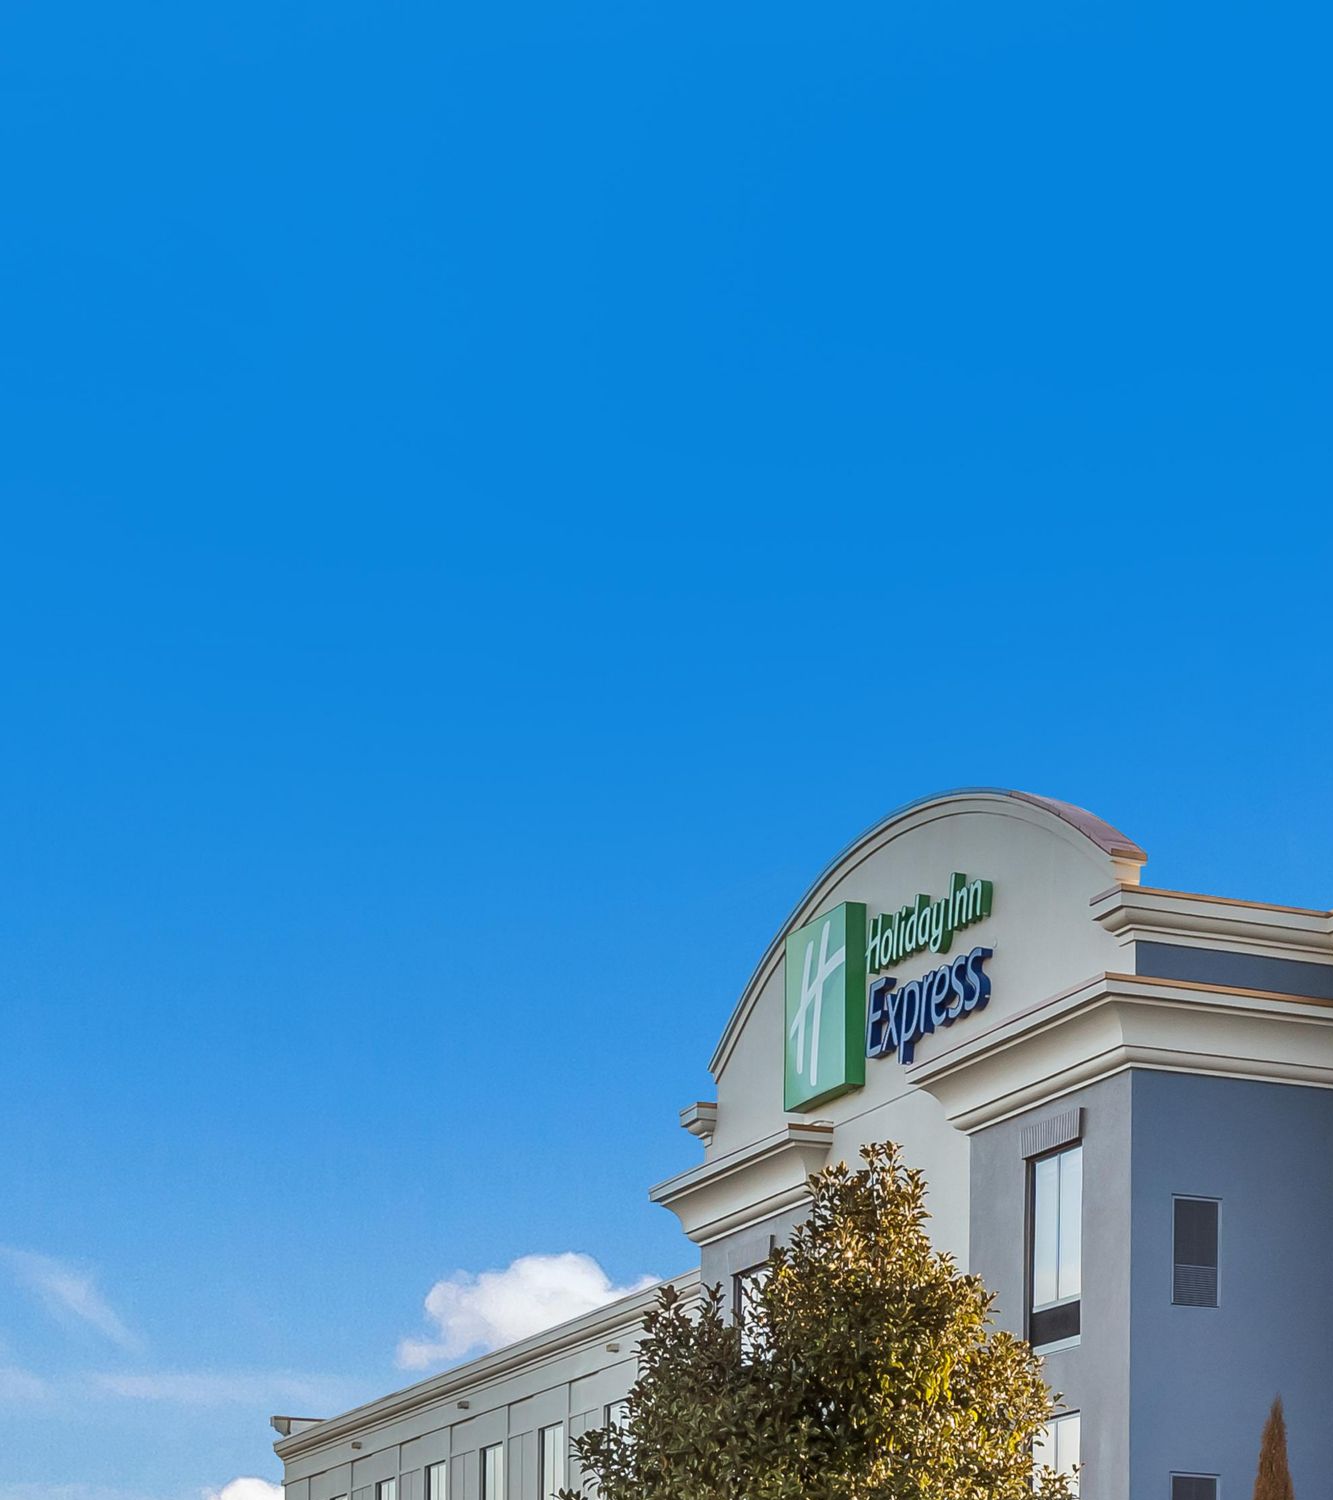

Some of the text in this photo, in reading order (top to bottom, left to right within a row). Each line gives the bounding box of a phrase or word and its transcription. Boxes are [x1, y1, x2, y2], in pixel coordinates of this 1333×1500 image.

[865, 872, 994, 975] Holiday Inn
[865, 946, 994, 1066] Express
